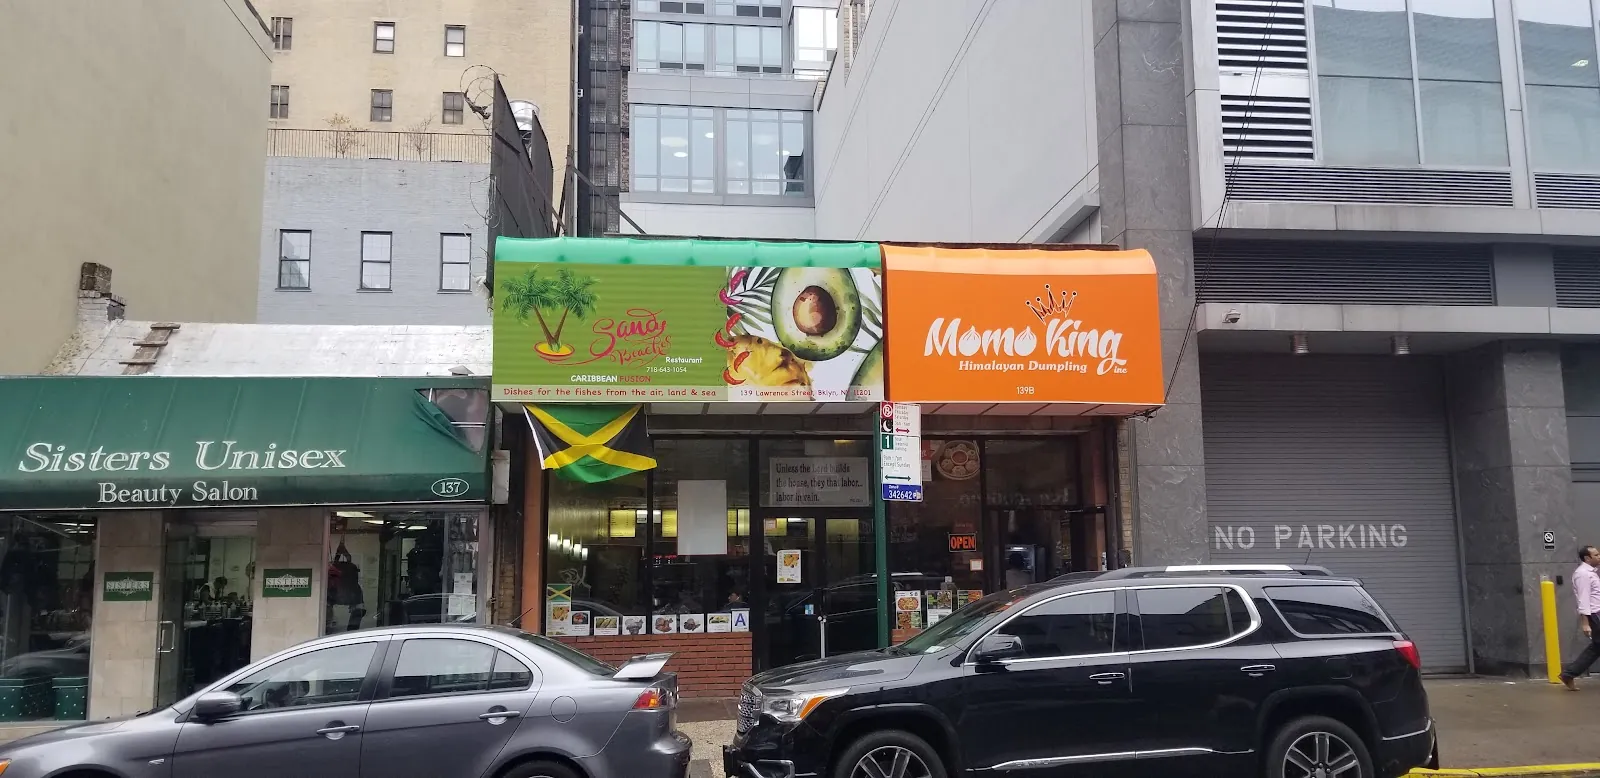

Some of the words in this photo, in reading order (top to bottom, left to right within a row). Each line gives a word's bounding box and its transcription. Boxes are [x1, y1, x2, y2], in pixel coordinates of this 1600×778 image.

[589, 308, 667, 357] Sandy
[923, 317, 1038, 357] Momo
[1045, 317, 1128, 376] King
[665, 356, 703, 364] Restaurant
[958, 360, 1025, 372] Himalayan
[1028, 360, 1088, 374] Dumpling
[1113, 365, 1128, 374] inc
[570, 374, 618, 383] CARIBBEAN
[619, 375, 652, 383] FUSION
[503, 387, 533, 396] Dishes
[537, 387, 551, 396] for
[556, 388, 571, 396] the
[575, 388, 602, 396] fishes
[606, 388, 627, 396] from
[631, 388, 646, 396] the
[650, 389, 664, 397] air,
[667, 388, 687, 396] land
[690, 388, 698, 396] &
[1016, 386, 1035, 395] 139B
[885, 435, 889, 449] 1
[18, 441, 171, 473] Sisters
[195, 440, 347, 472] Unisex
[775, 463, 799, 473] Unless
[800, 463, 811, 473] the
[812, 464, 828, 473] Lord
[829, 463, 851, 473] builds
[439, 480, 462, 495] 137
[776, 477, 787, 487] the
[788, 477, 809, 489] house,
[810, 477, 826, 489] they
[97, 481, 182, 506] Beauty
[191, 480, 258, 502] Salon
[775, 492, 794, 502] labor
[795, 492, 802, 502] in
[803, 492, 820, 502] vain.
[888, 489, 913, 500] 342642
[950, 535, 975, 550] OPEN
[1214, 525, 1255, 550] NO
[1274, 523, 1408, 550] PARKING
[106, 580, 150, 588] SISTERS
[265, 577, 309, 585] SISTERS
[734, 612, 746, 627] A
